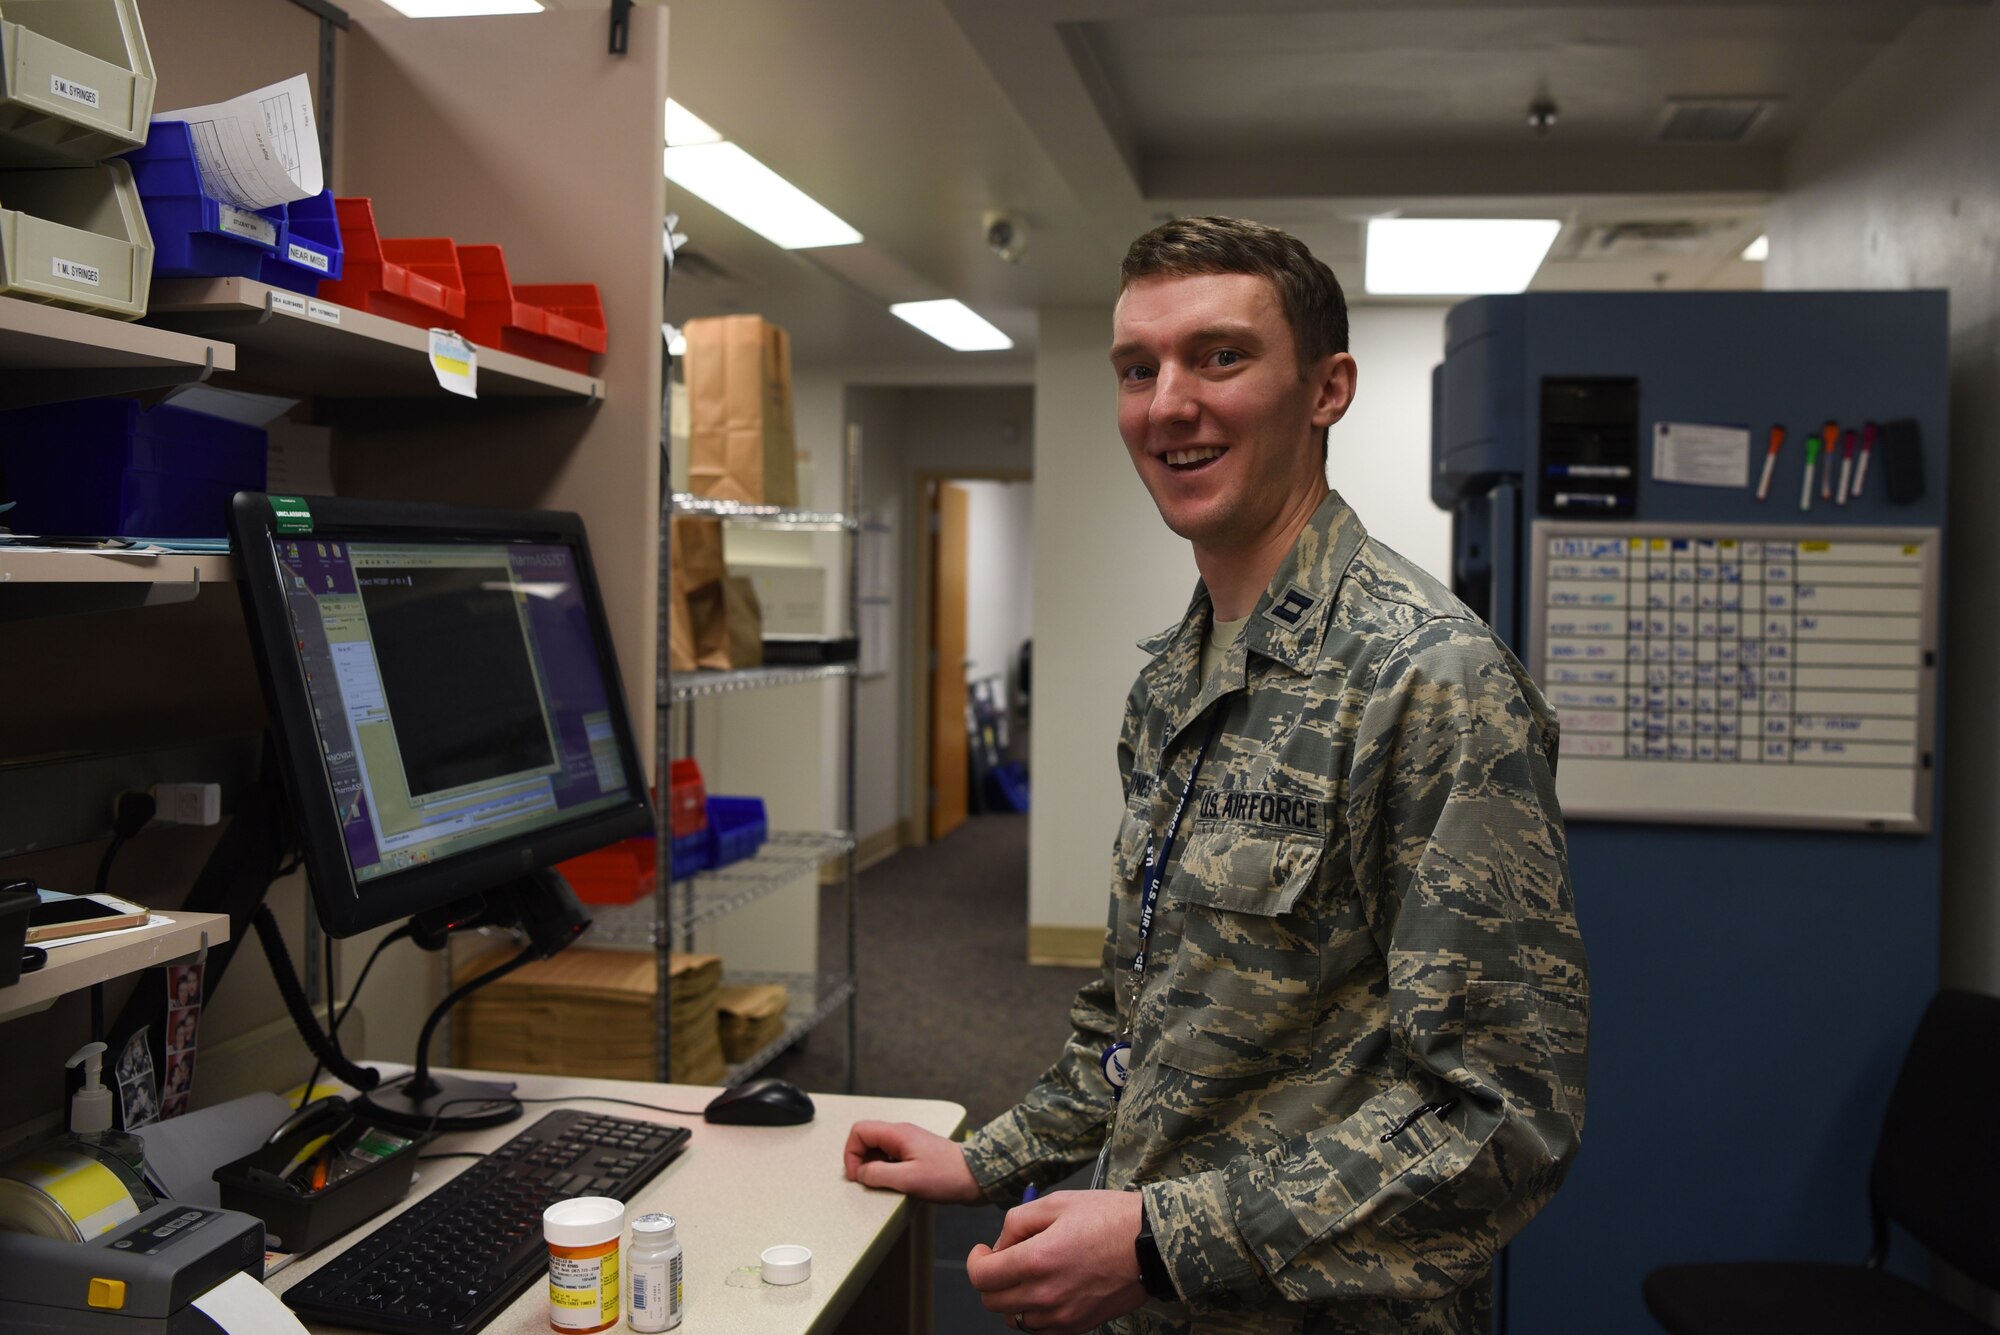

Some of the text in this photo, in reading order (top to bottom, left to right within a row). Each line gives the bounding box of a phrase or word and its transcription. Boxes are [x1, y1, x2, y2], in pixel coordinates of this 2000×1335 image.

[54, 79, 96, 104] 5 ML SYRINGES
[262, 147, 270, 161] Page
[233, 218, 250, 229] STUDENT
[290, 247, 326, 268] NEAR MISS
[62, 263, 70, 275] ML
[71, 265, 98, 282] SYRINGES
[511, 553, 567, 568] harmASSIST
[1200, 793, 1219, 818] U.S.
[1168, 796, 1185, 838] FORCE
[1148, 878, 1160, 902] U.S.
[1141, 904, 1153, 928] AIR
